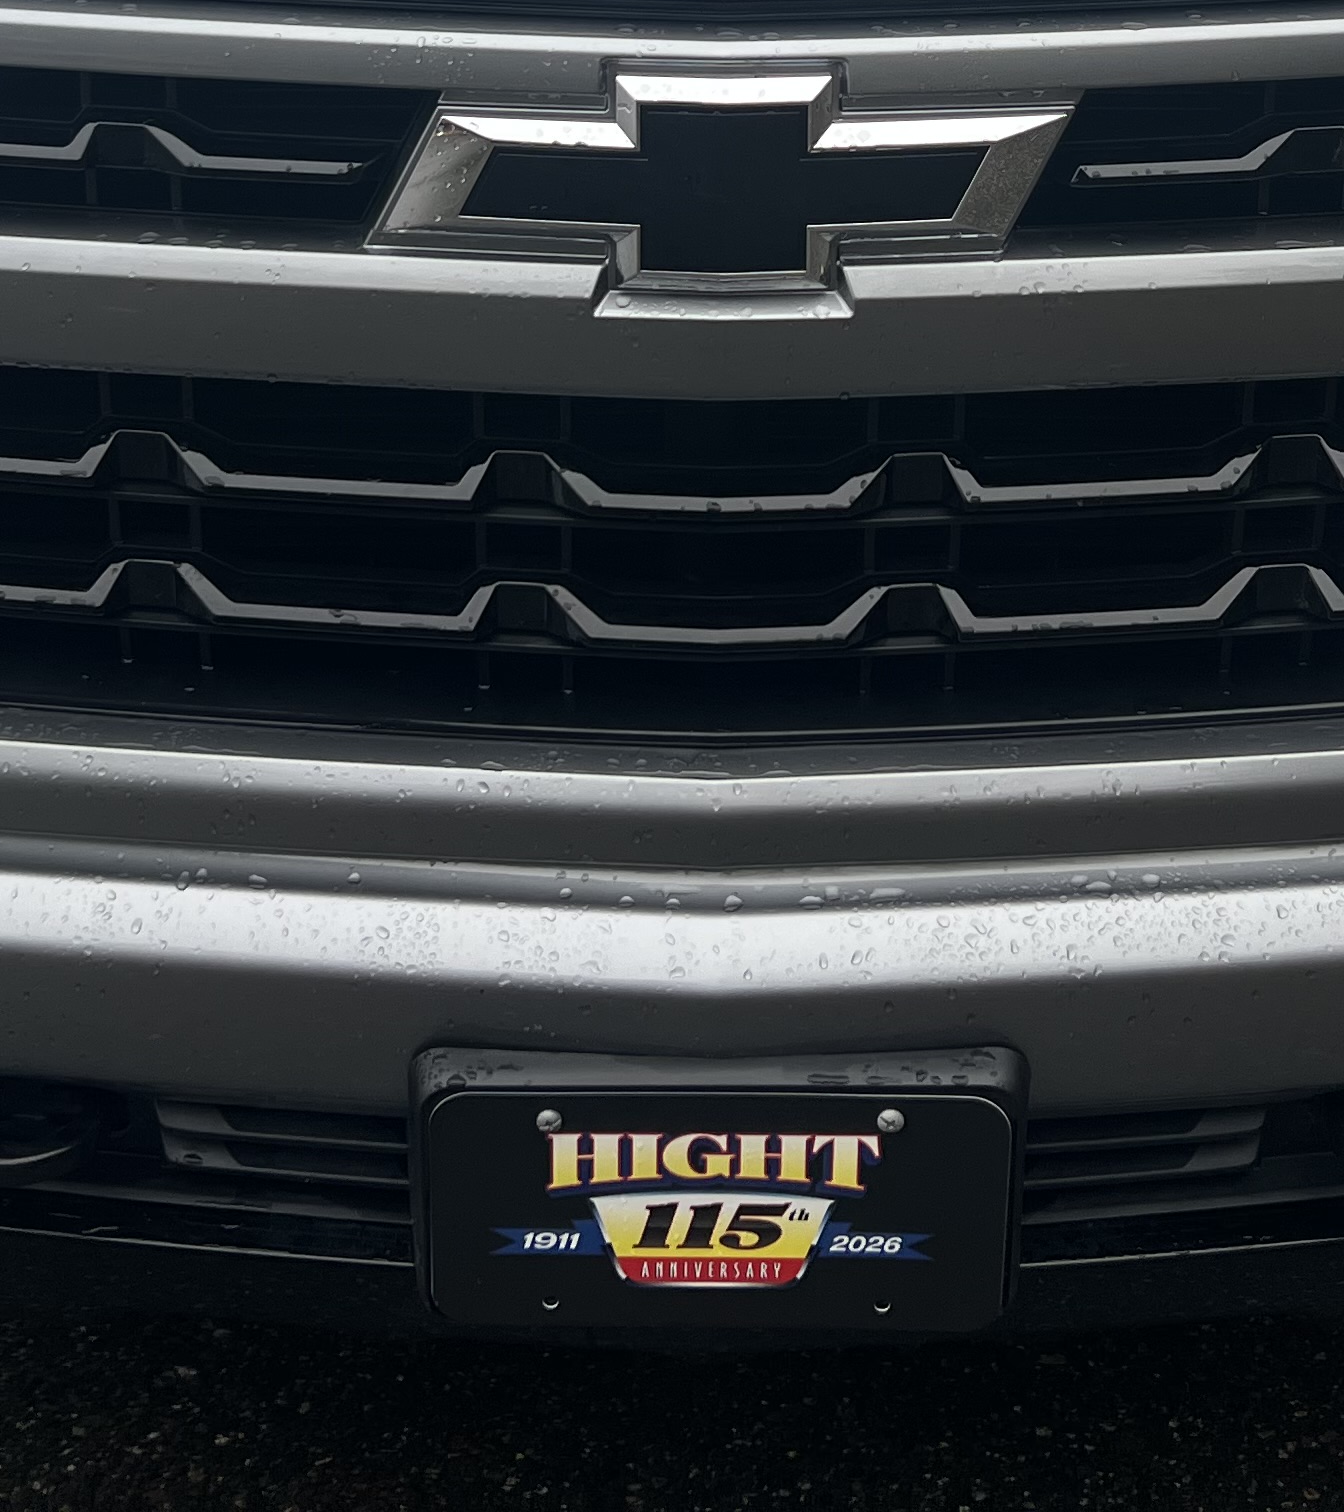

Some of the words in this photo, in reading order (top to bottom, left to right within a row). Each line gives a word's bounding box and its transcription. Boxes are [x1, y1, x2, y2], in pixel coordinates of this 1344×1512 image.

[546, 1132, 882, 1191] HIGHT
[523, 1232, 580, 1250] 1911
[829, 1235, 902, 1253] 2026
[642, 1261, 781, 1279] ANNIVERSARY
